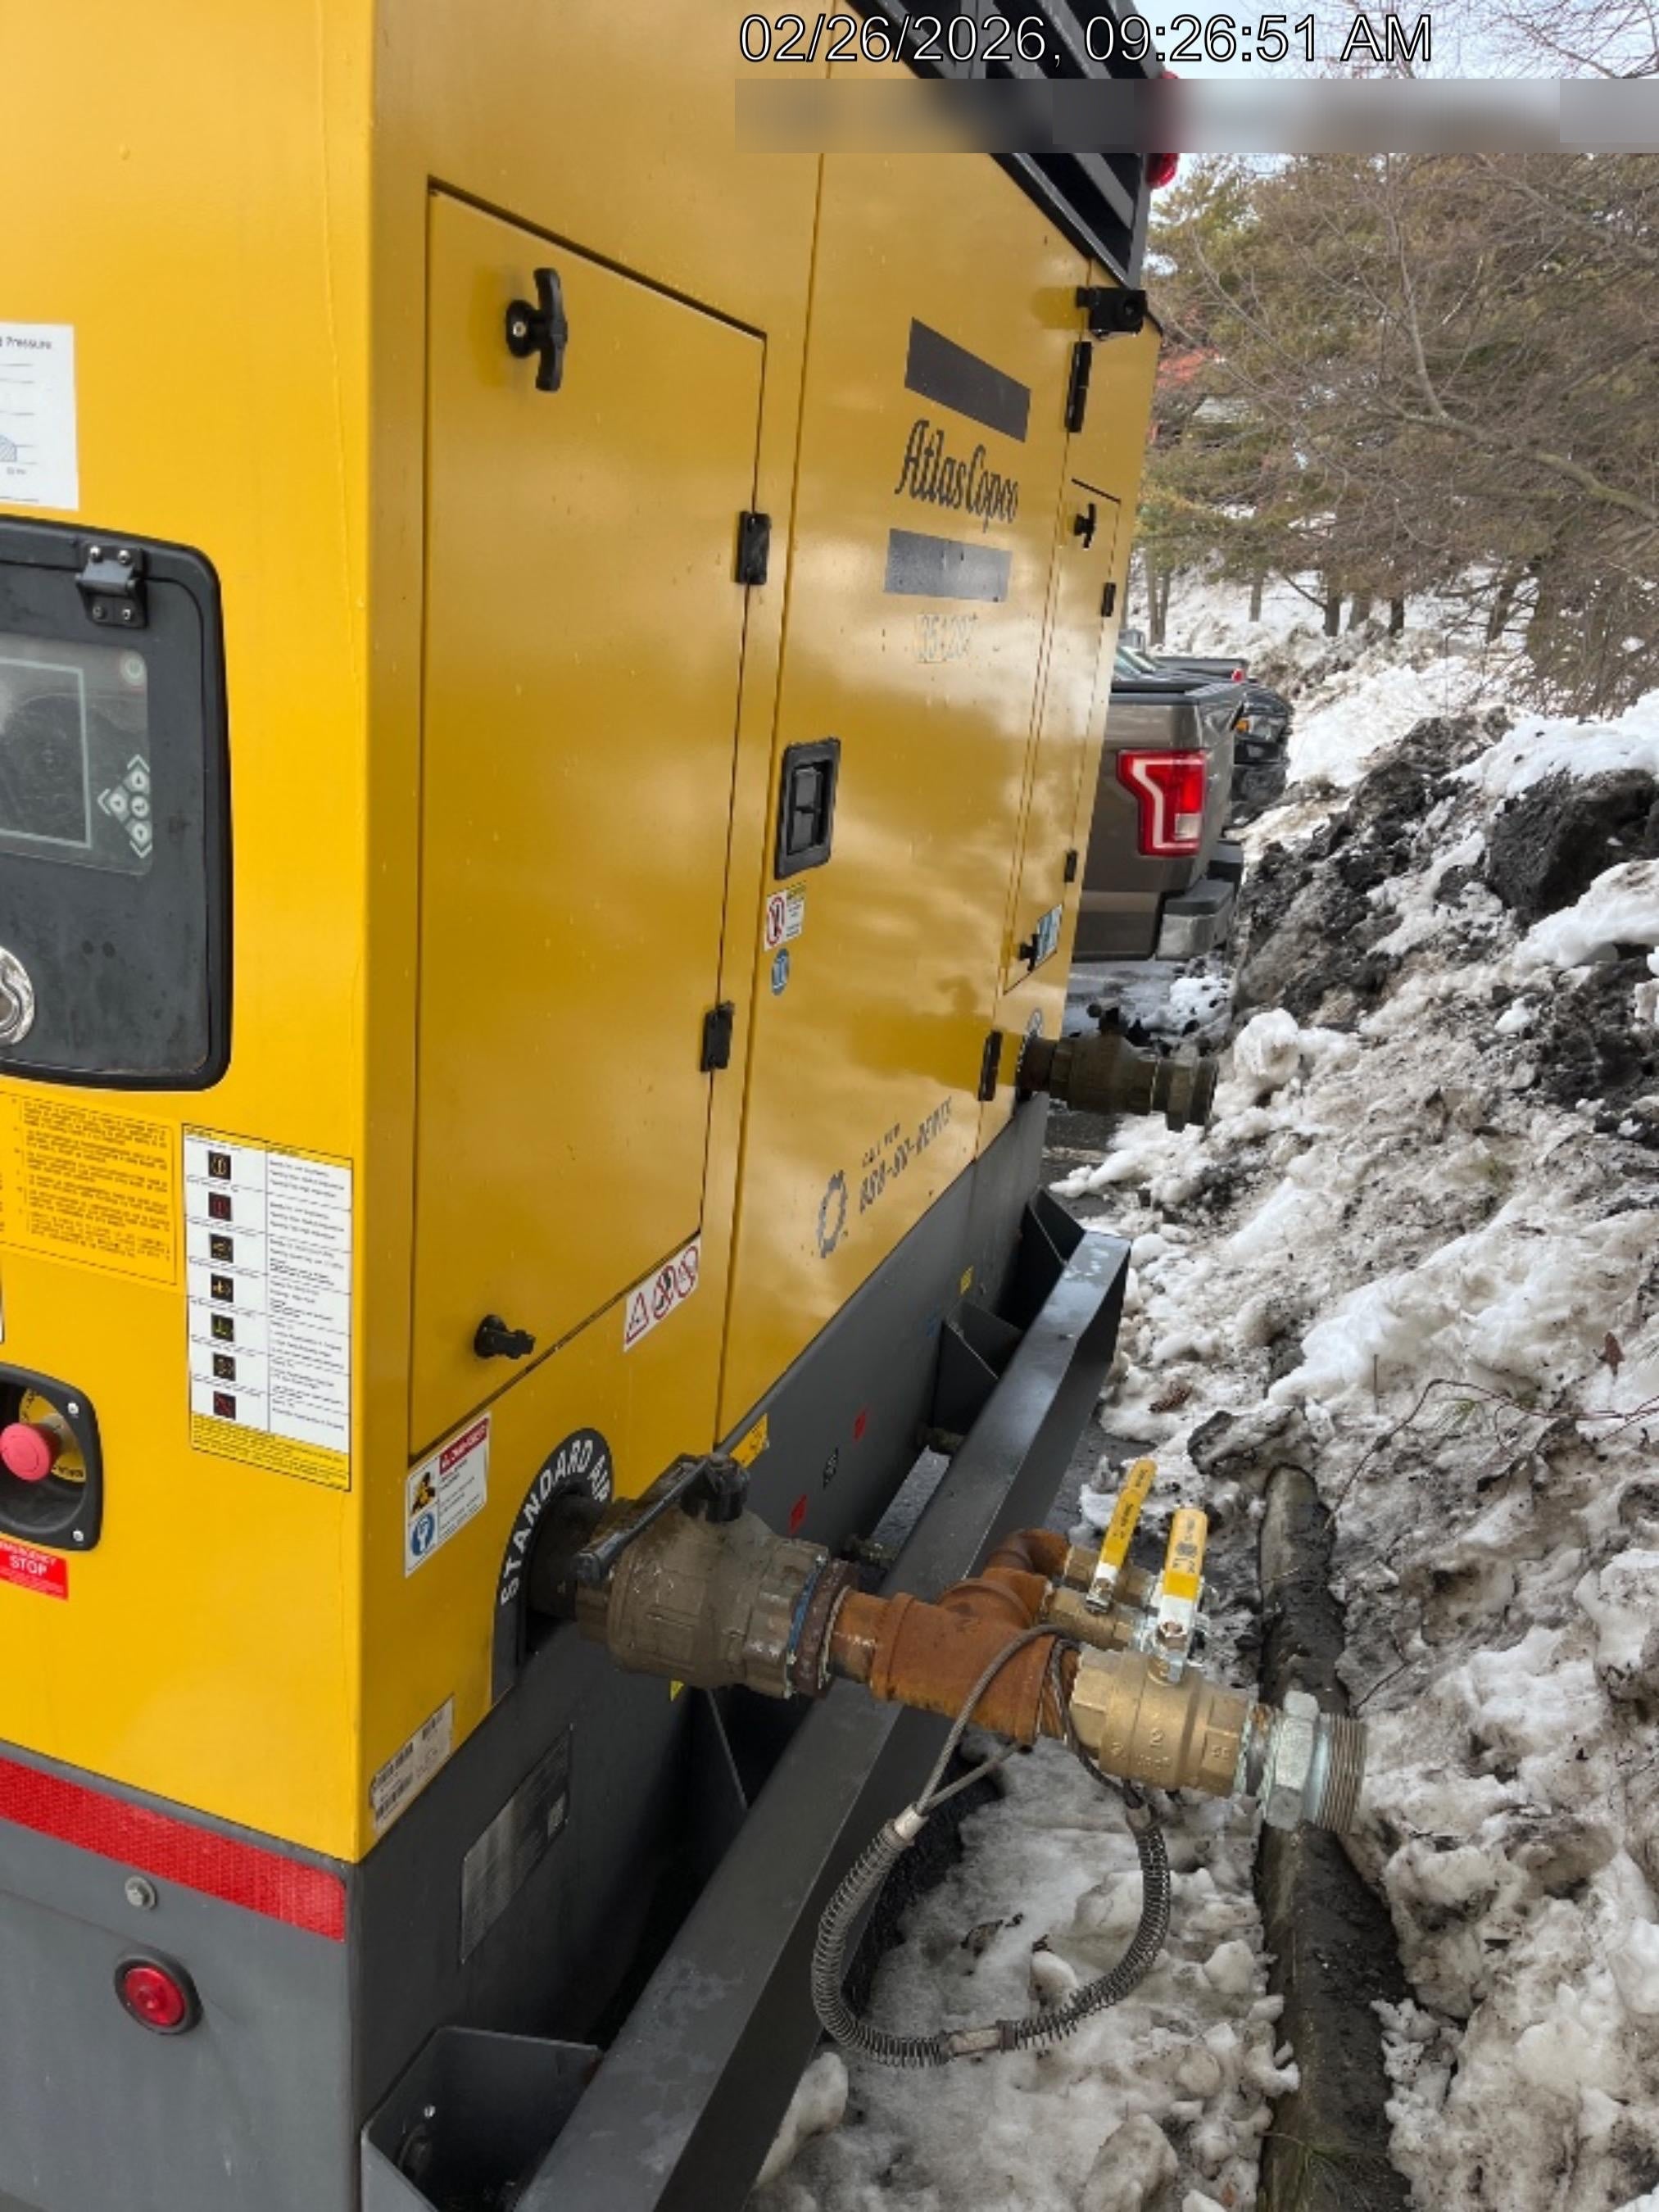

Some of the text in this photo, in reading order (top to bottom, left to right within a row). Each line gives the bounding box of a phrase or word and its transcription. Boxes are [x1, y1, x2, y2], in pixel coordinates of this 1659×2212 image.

[9, 1555, 48, 1577] STOP
[501, 1439, 593, 1607] STANDARD
[587, 1455, 612, 1503] AIR
